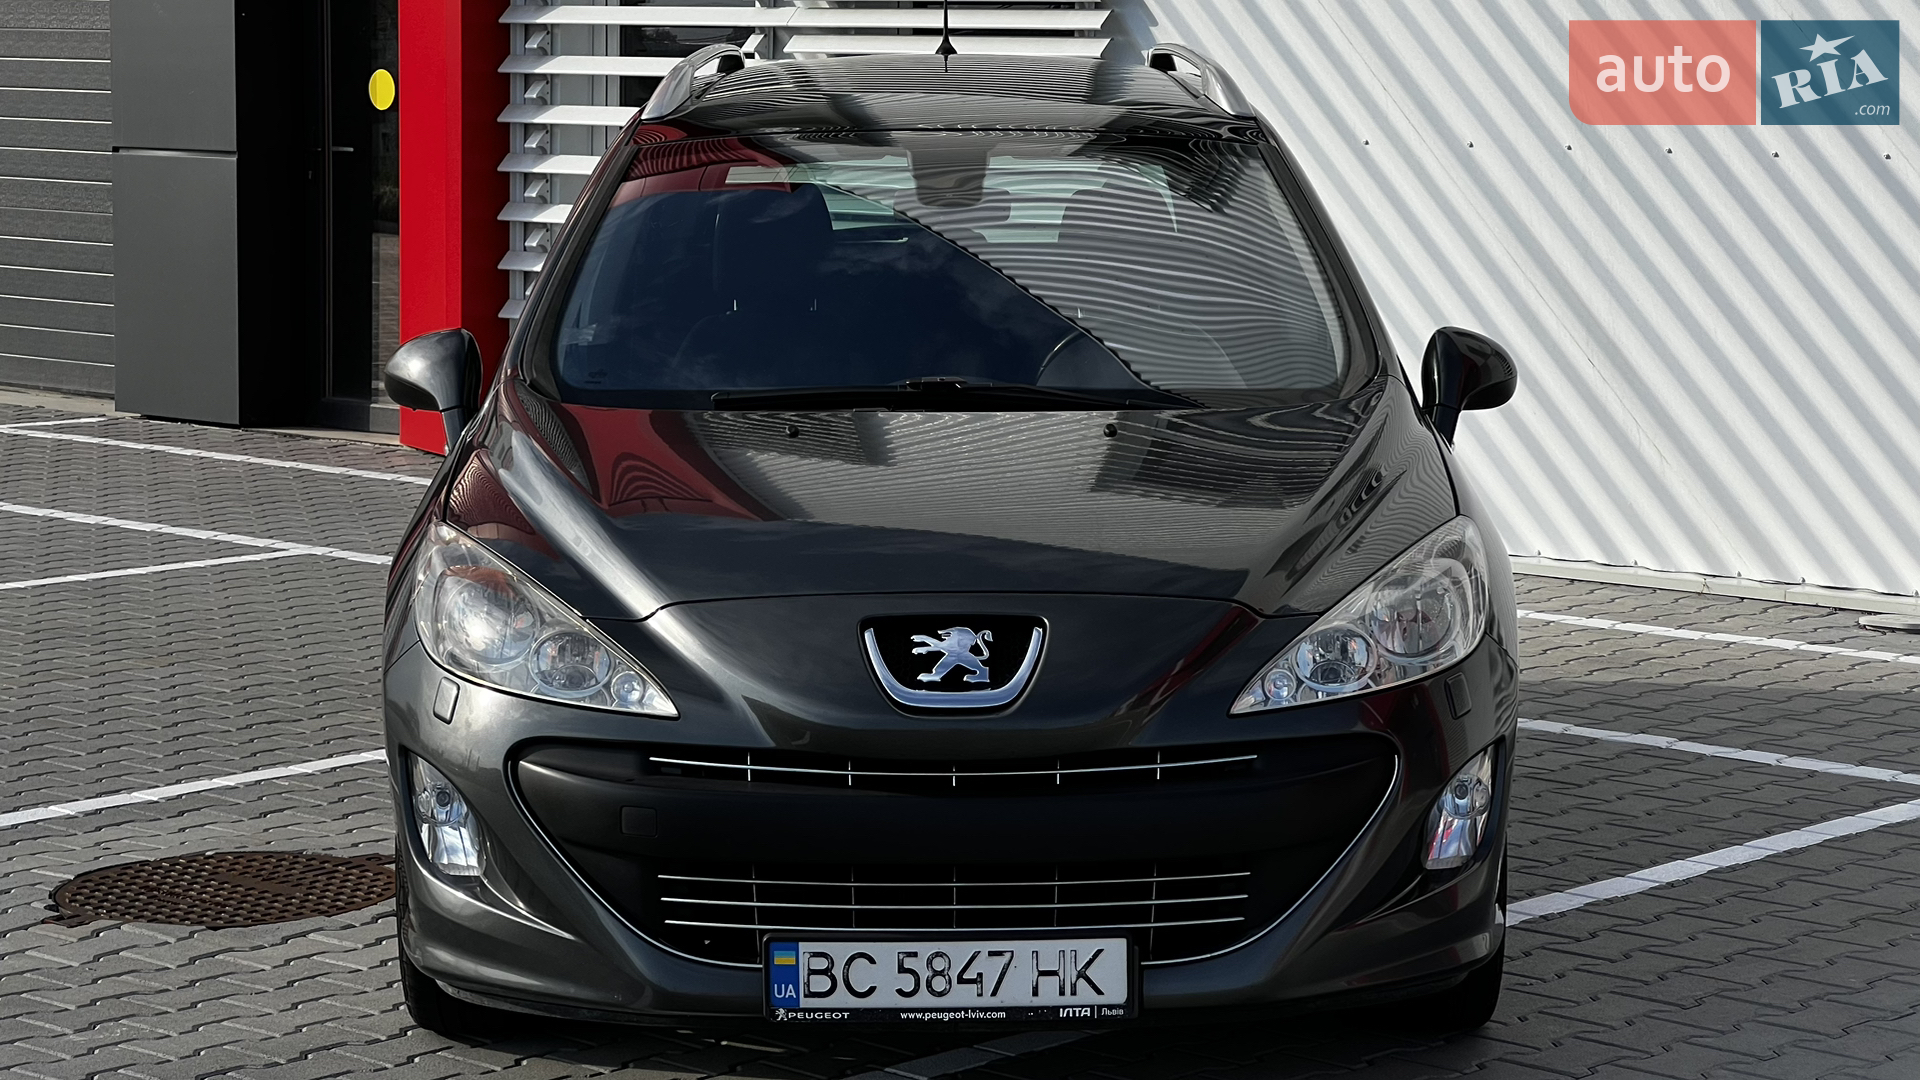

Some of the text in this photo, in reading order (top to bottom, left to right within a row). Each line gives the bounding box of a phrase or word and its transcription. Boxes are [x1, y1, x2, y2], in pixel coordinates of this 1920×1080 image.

[802, 948, 1106, 999] BC 5847 HK
[774, 983, 797, 999] UA
[900, 1009, 1006, 1021] www.peugeot-lviv.com
